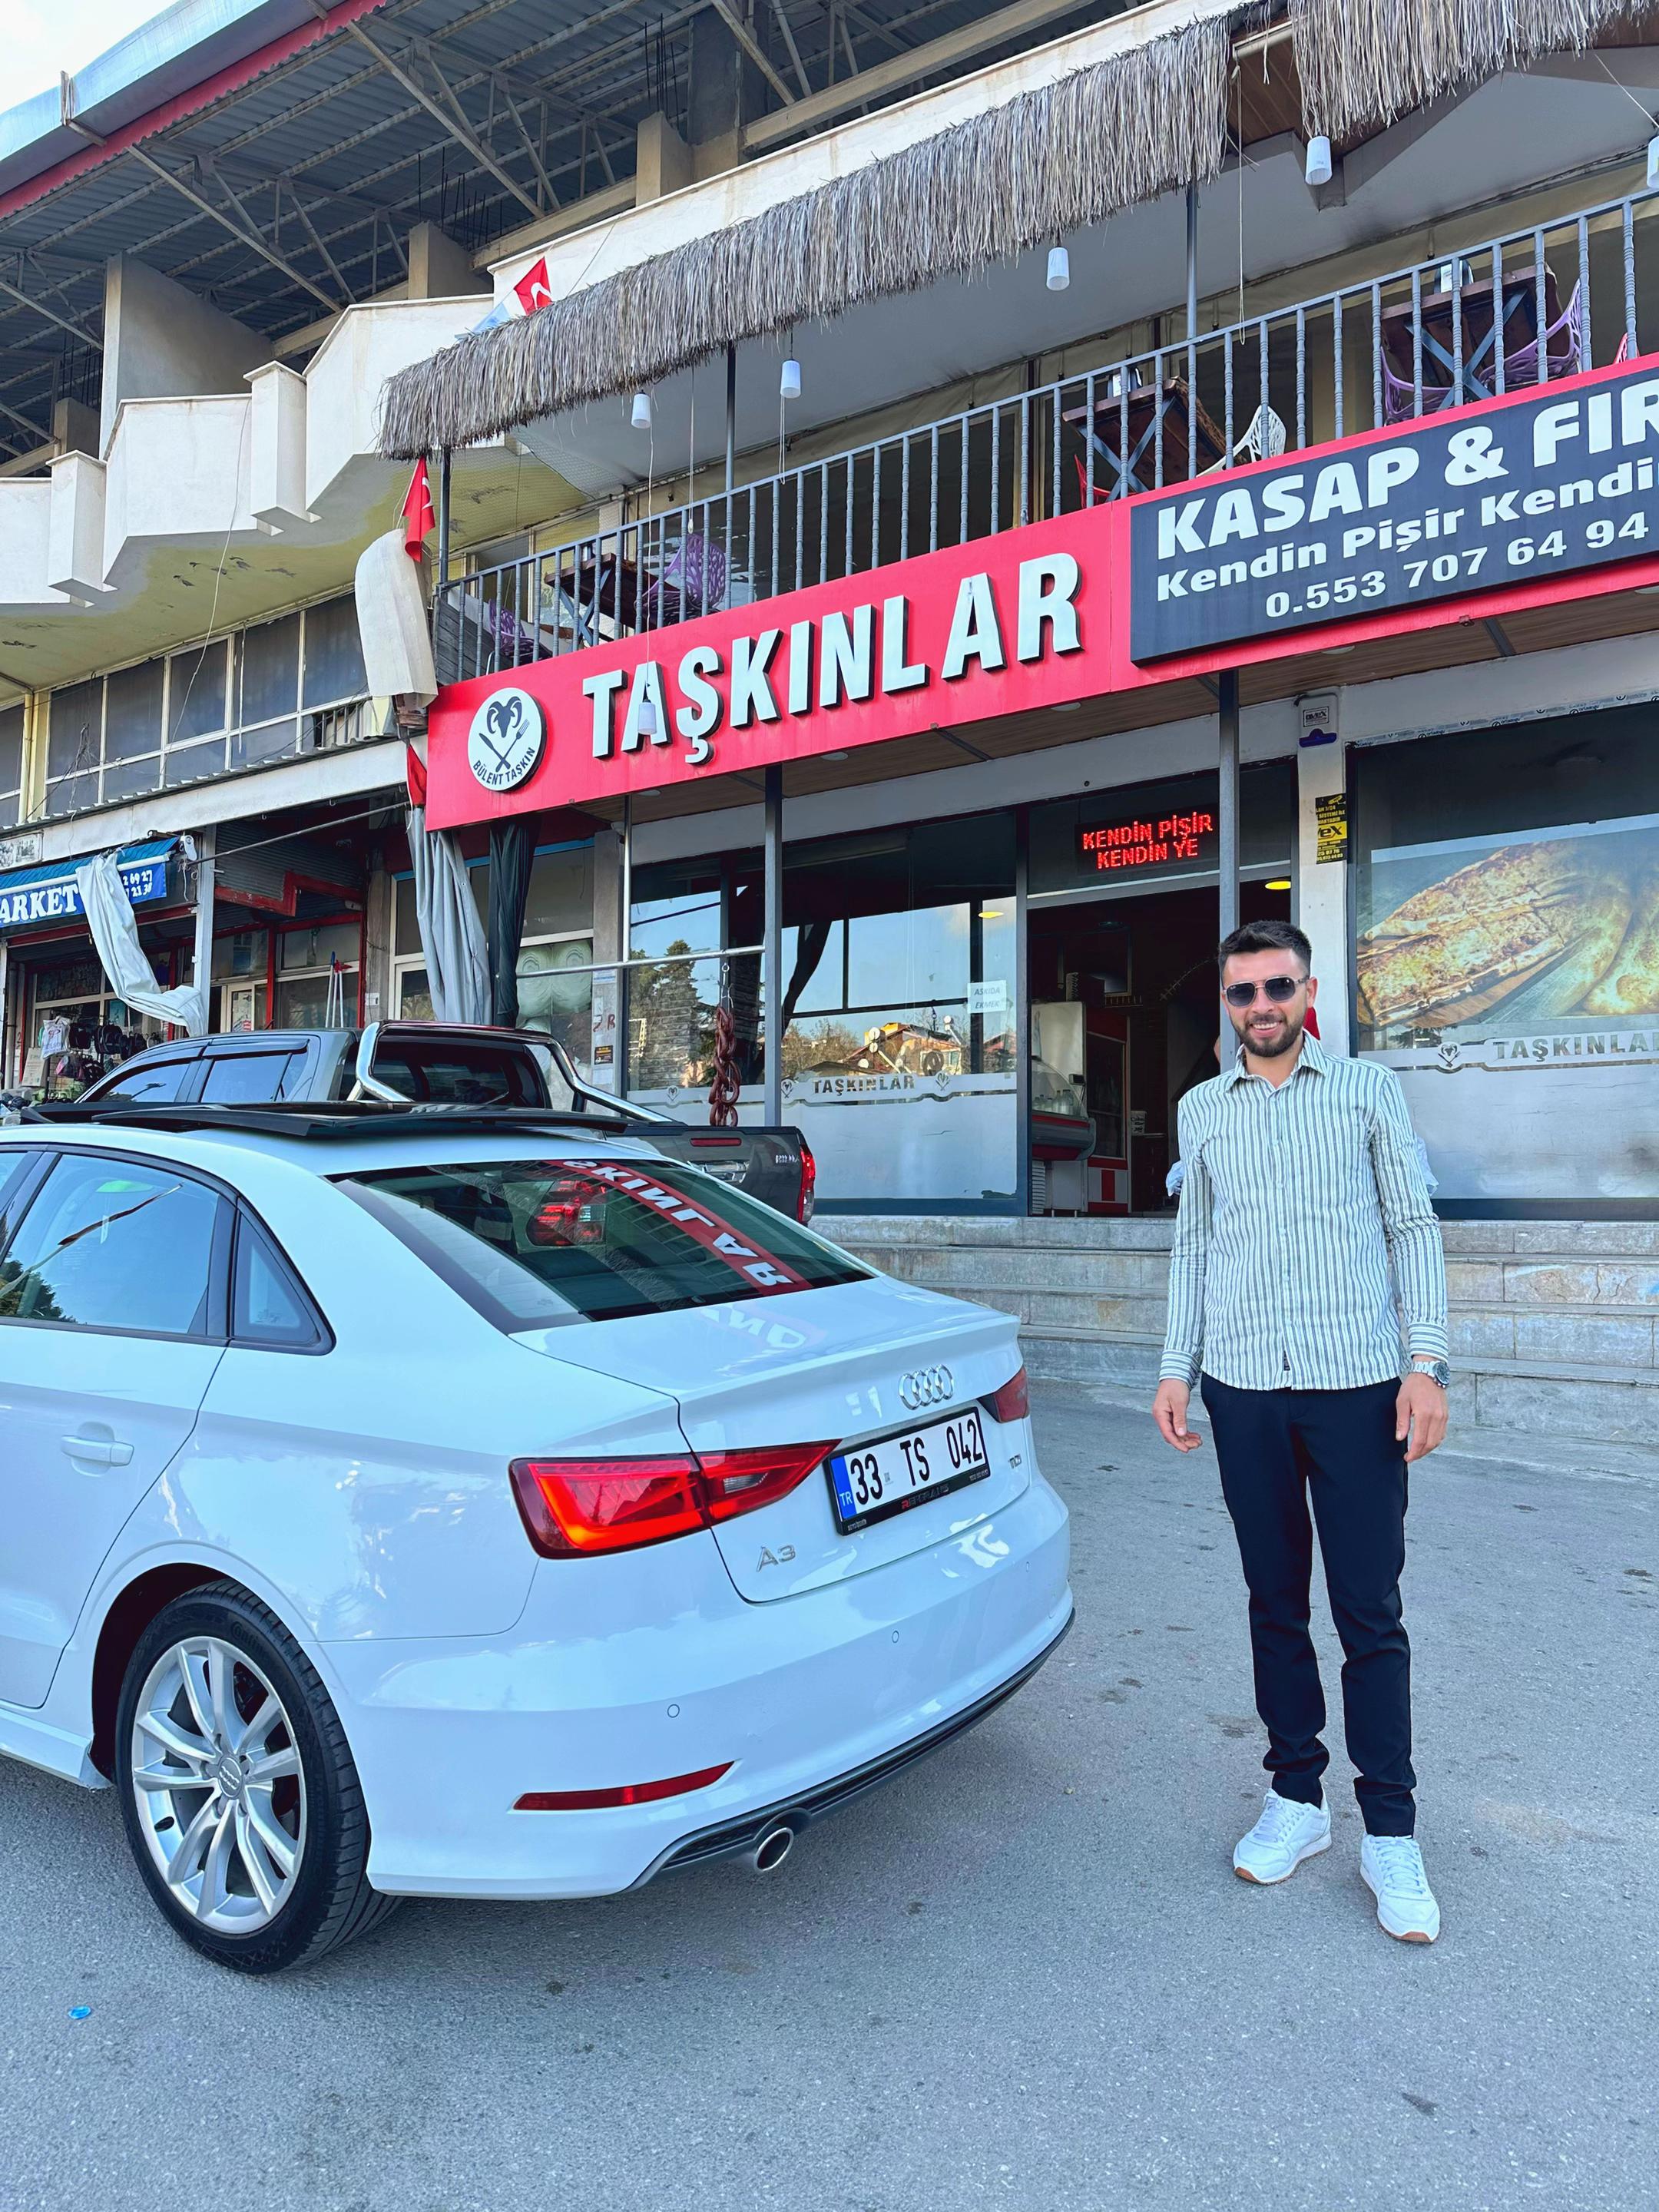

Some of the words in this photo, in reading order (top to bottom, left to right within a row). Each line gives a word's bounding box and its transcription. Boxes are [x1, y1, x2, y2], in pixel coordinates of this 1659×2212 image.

[1158, 447, 1419, 560] KASAP
[1445, 426, 1509, 486] &
[1157, 542, 1326, 601] Kendin
[1343, 508, 1465, 558] Pişir
[1482, 457, 1659, 526] Kendi
[1267, 571, 1386, 618] 0.553
[1403, 547, 1488, 588] 707
[1507, 530, 1567, 565] 64
[1586, 511, 1649, 549] 94
[582, 553, 1084, 766] TAŞKINLAR
[472, 760, 504, 785] BÜLENT
[1083, 821, 1151, 849] KENDİN
[1158, 811, 1213, 839] PİŞİR
[1098, 840, 1167, 869] KENDİN
[1174, 838, 1198, 858] YE
[813, 1075, 916, 1096] TAŞKINLAR
[850, 1454, 883, 1505] 33
[899, 1437, 930, 1486] TS
[945, 1419, 983, 1469] 042
[839, 1492, 853, 1507] TR
[756, 1545, 796, 1572] A3
